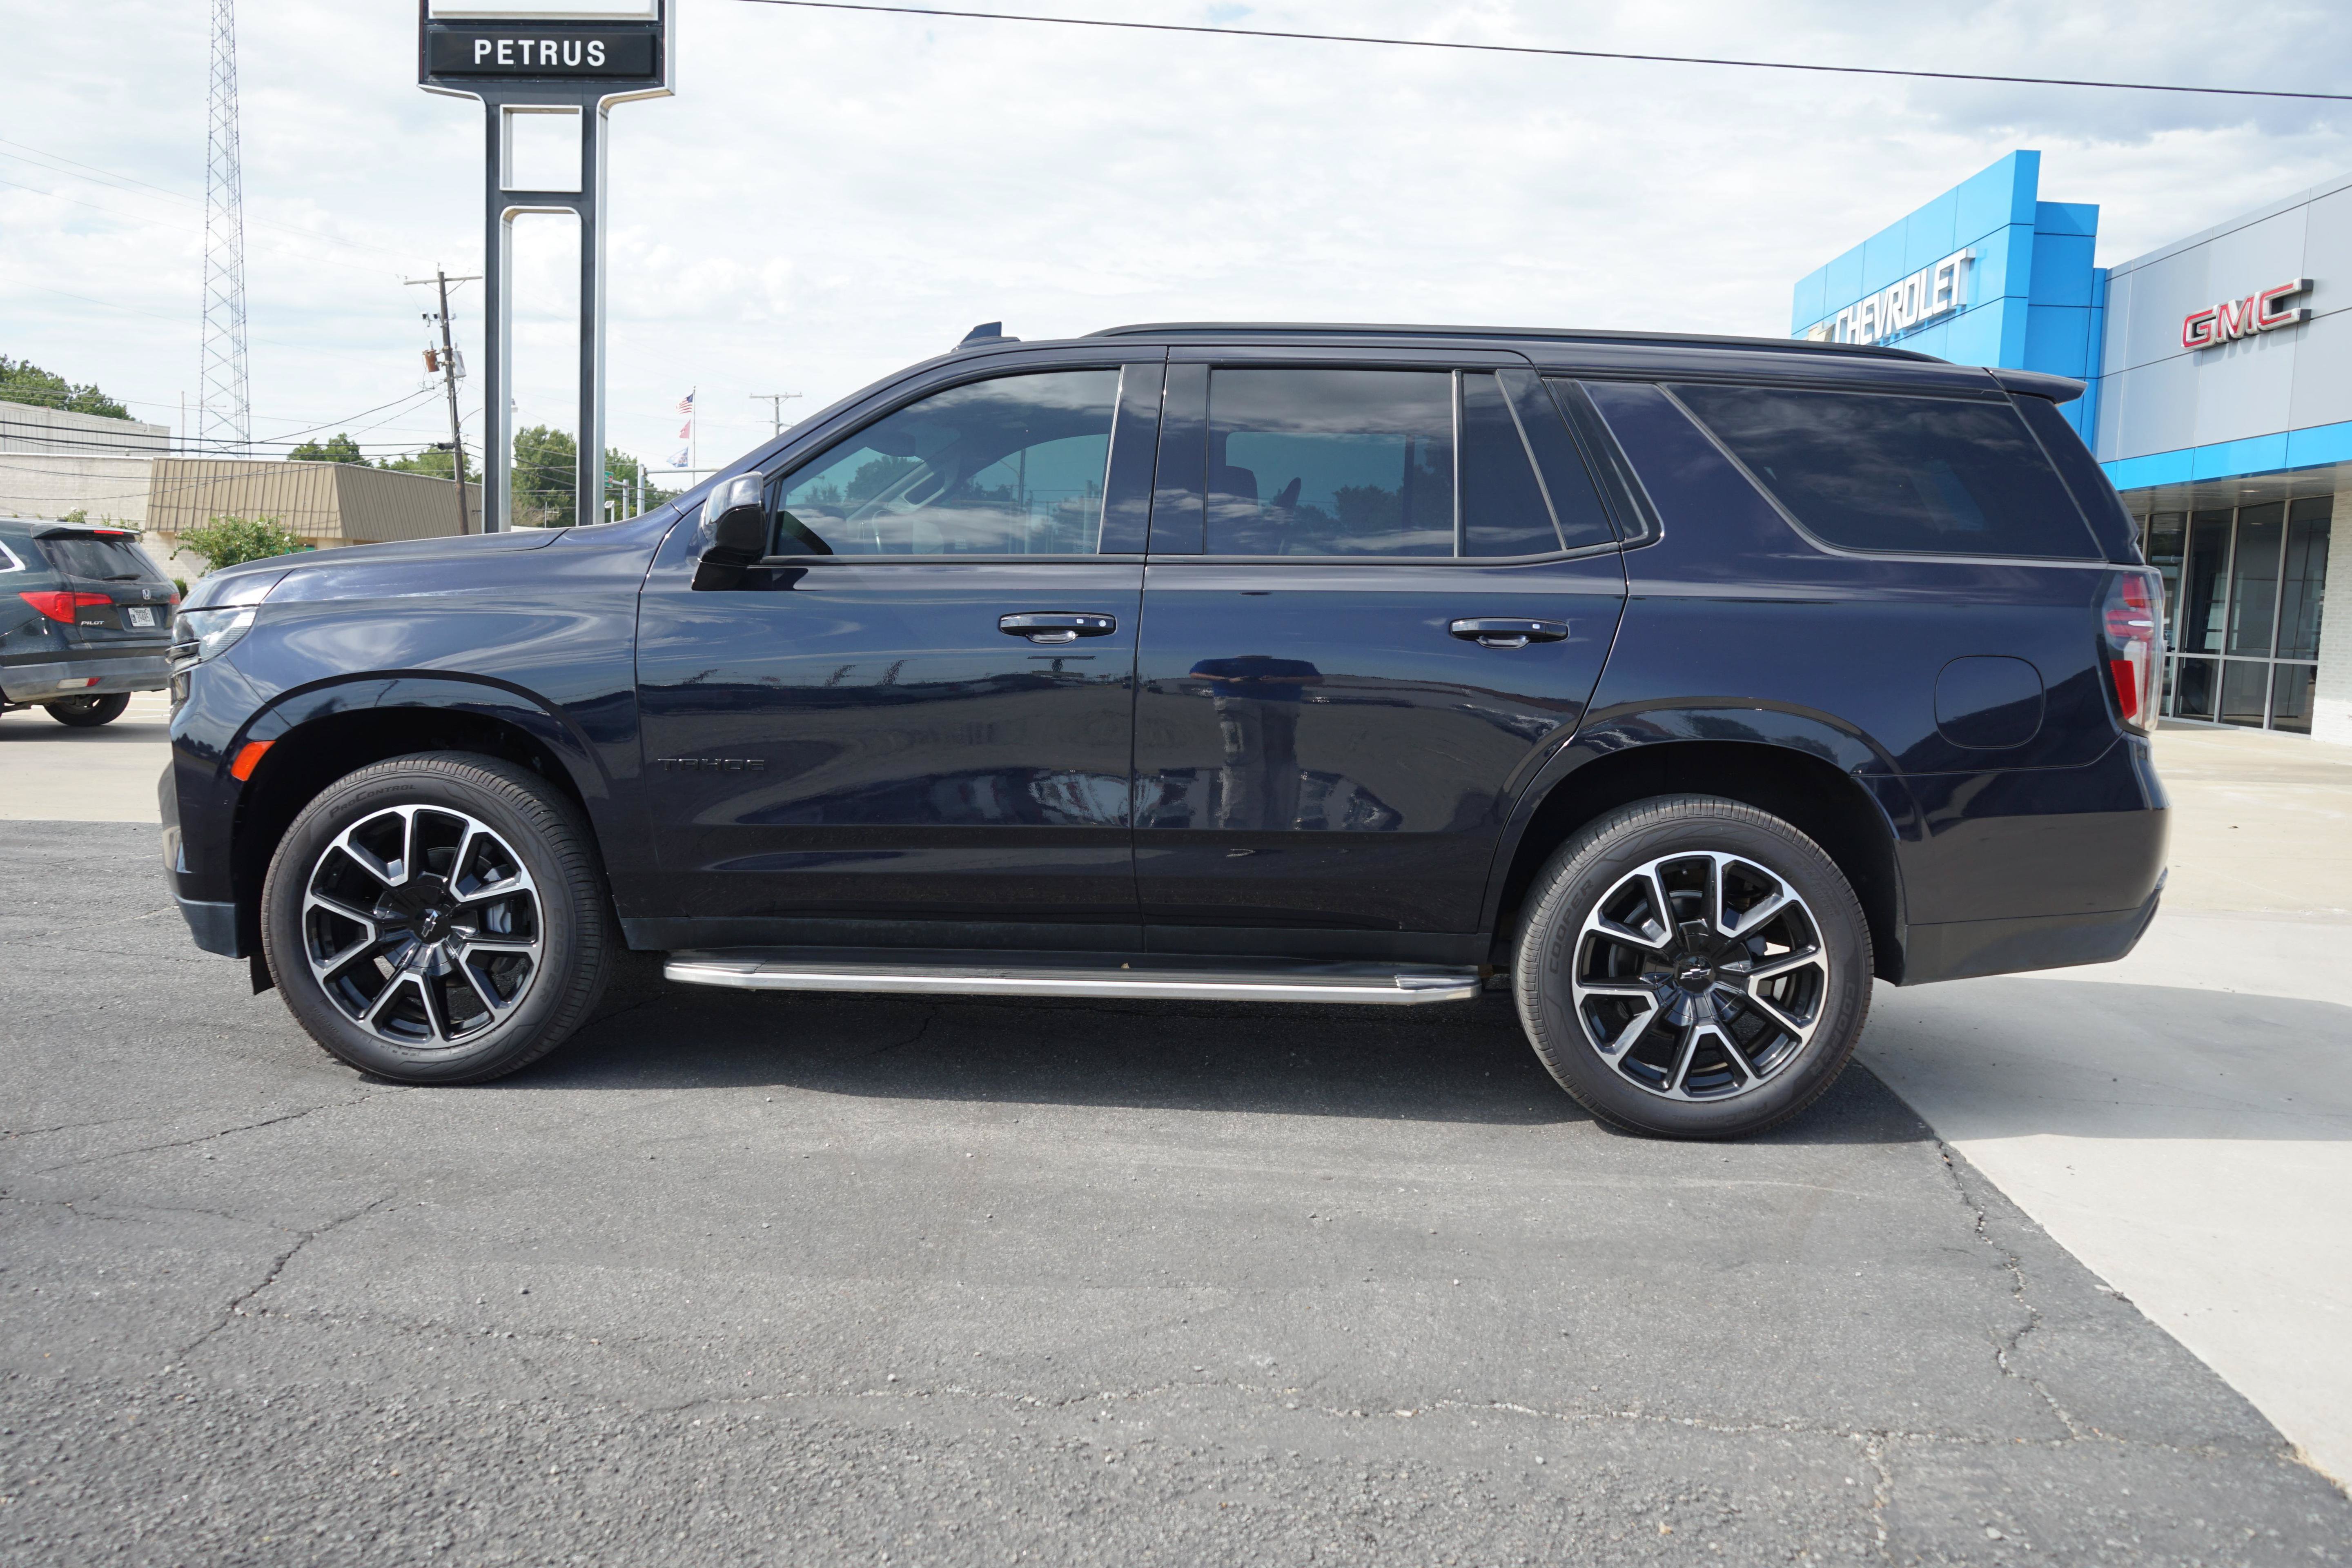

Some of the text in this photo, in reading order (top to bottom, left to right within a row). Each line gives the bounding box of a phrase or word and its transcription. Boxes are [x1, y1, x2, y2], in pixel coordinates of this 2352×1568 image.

[474, 39, 606, 67] PETRUS
[1835, 248, 1976, 345] CHEVROLET
[2181, 278, 2304, 351] GMC
[657, 758, 765, 771] TAHOE
[539, 907, 564, 1004] COOPER
[1549, 879, 1594, 974] COOPER
[1809, 982, 1855, 1075] COOPER
